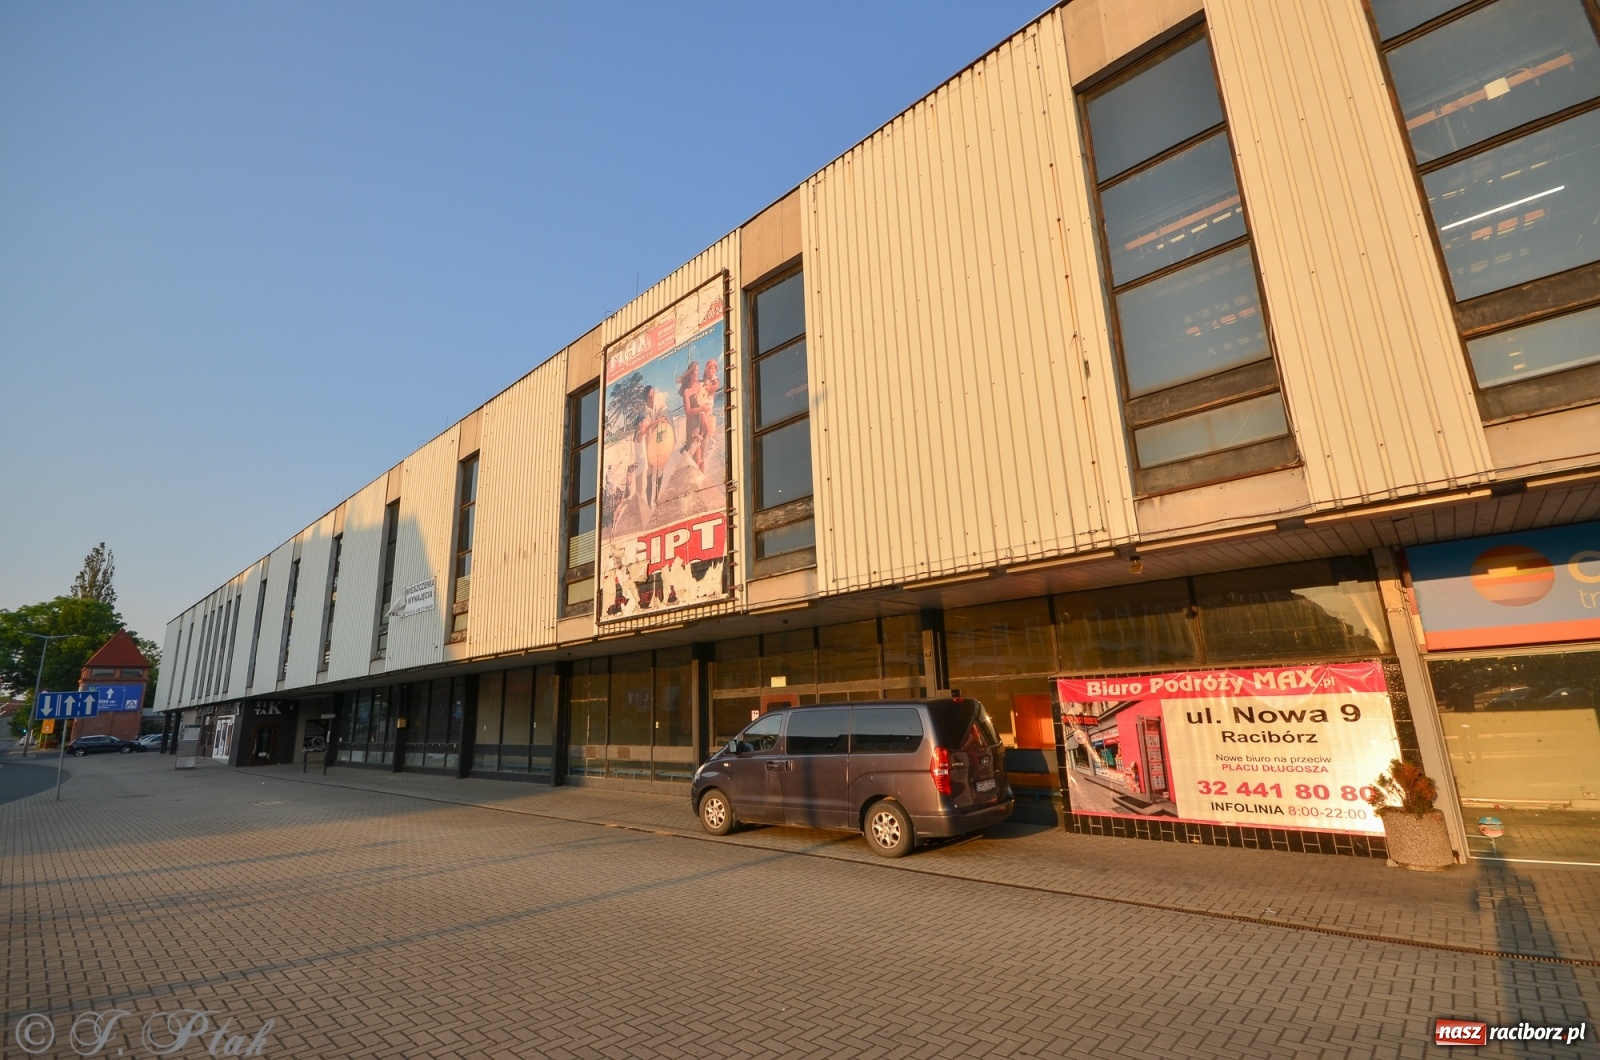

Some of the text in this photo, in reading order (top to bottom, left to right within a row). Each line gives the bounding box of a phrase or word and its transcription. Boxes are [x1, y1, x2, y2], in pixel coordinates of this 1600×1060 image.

[1086, 681, 1143, 697] Biuro
[1149, 673, 1244, 695] Podróży
[1187, 703, 1362, 724] ul. Nowa 9
[1221, 730, 1318, 743] Racibórz
[1215, 754, 1243, 763] Nowe
[1245, 754, 1272, 763] biuro
[1290, 755, 1332, 764] przeciw
[1221, 763, 1329, 773] PLACU DŁUGOSZA
[1197, 780, 1375, 801] 32 441 80 80
[1211, 801, 1367, 820] INFOLINIA 8:00-22:00
